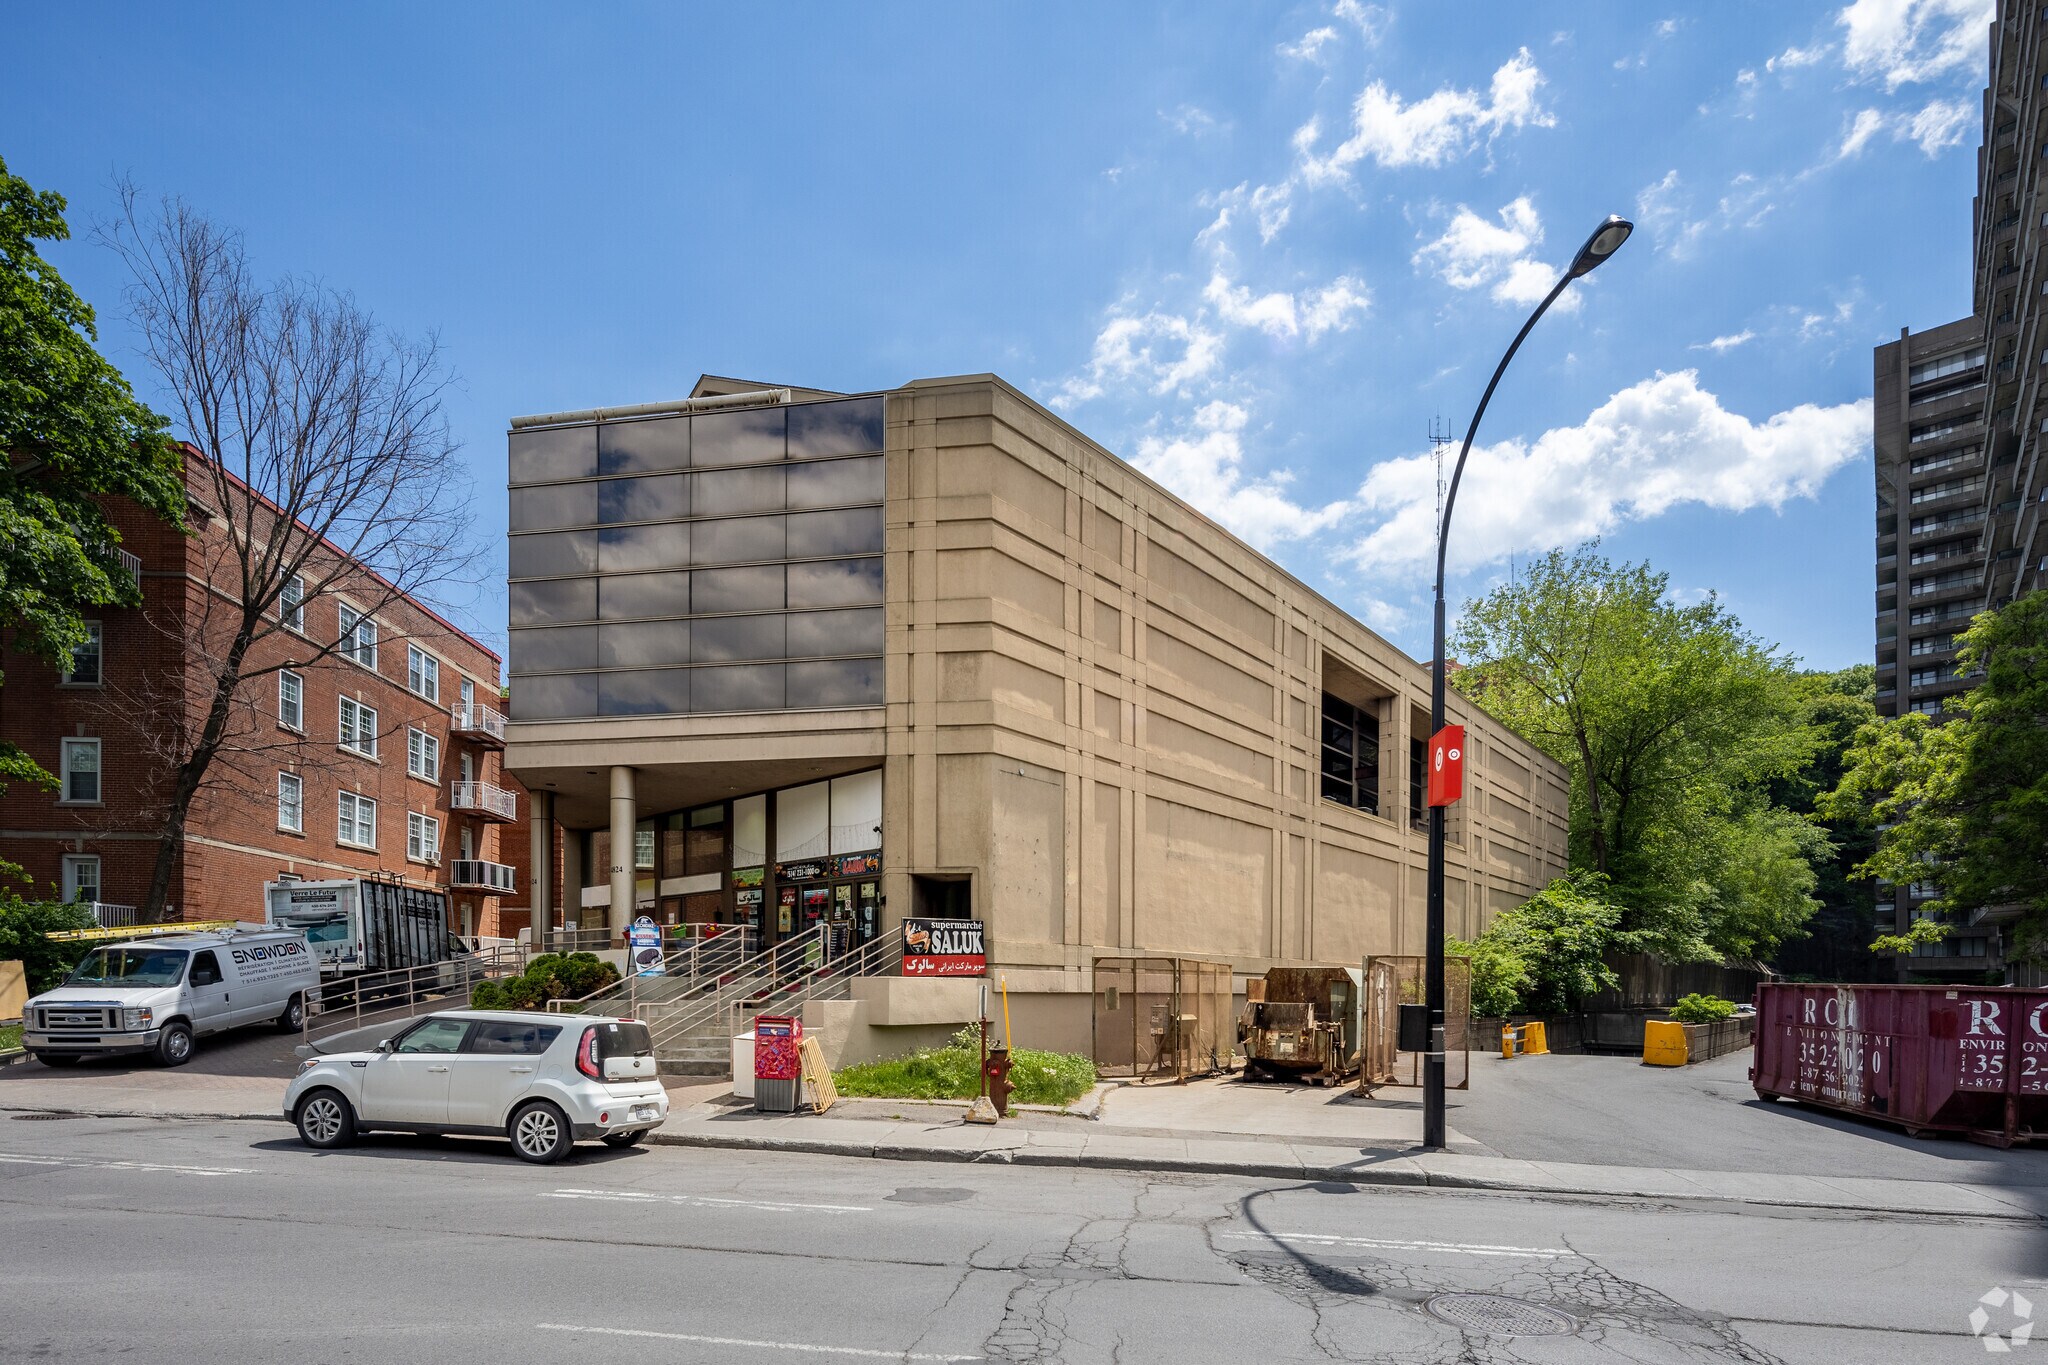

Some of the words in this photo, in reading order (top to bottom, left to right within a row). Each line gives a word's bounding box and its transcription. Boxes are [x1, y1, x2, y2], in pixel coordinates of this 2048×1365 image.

[931, 921, 982, 930] supermarché
[932, 930, 984, 954] SALUK
[232, 941, 306, 964] SNOWDON
[906, 958, 934, 973] سالوک
[955, 962, 972, 970] مارکت
[1804, 998, 1854, 1026] RCI
